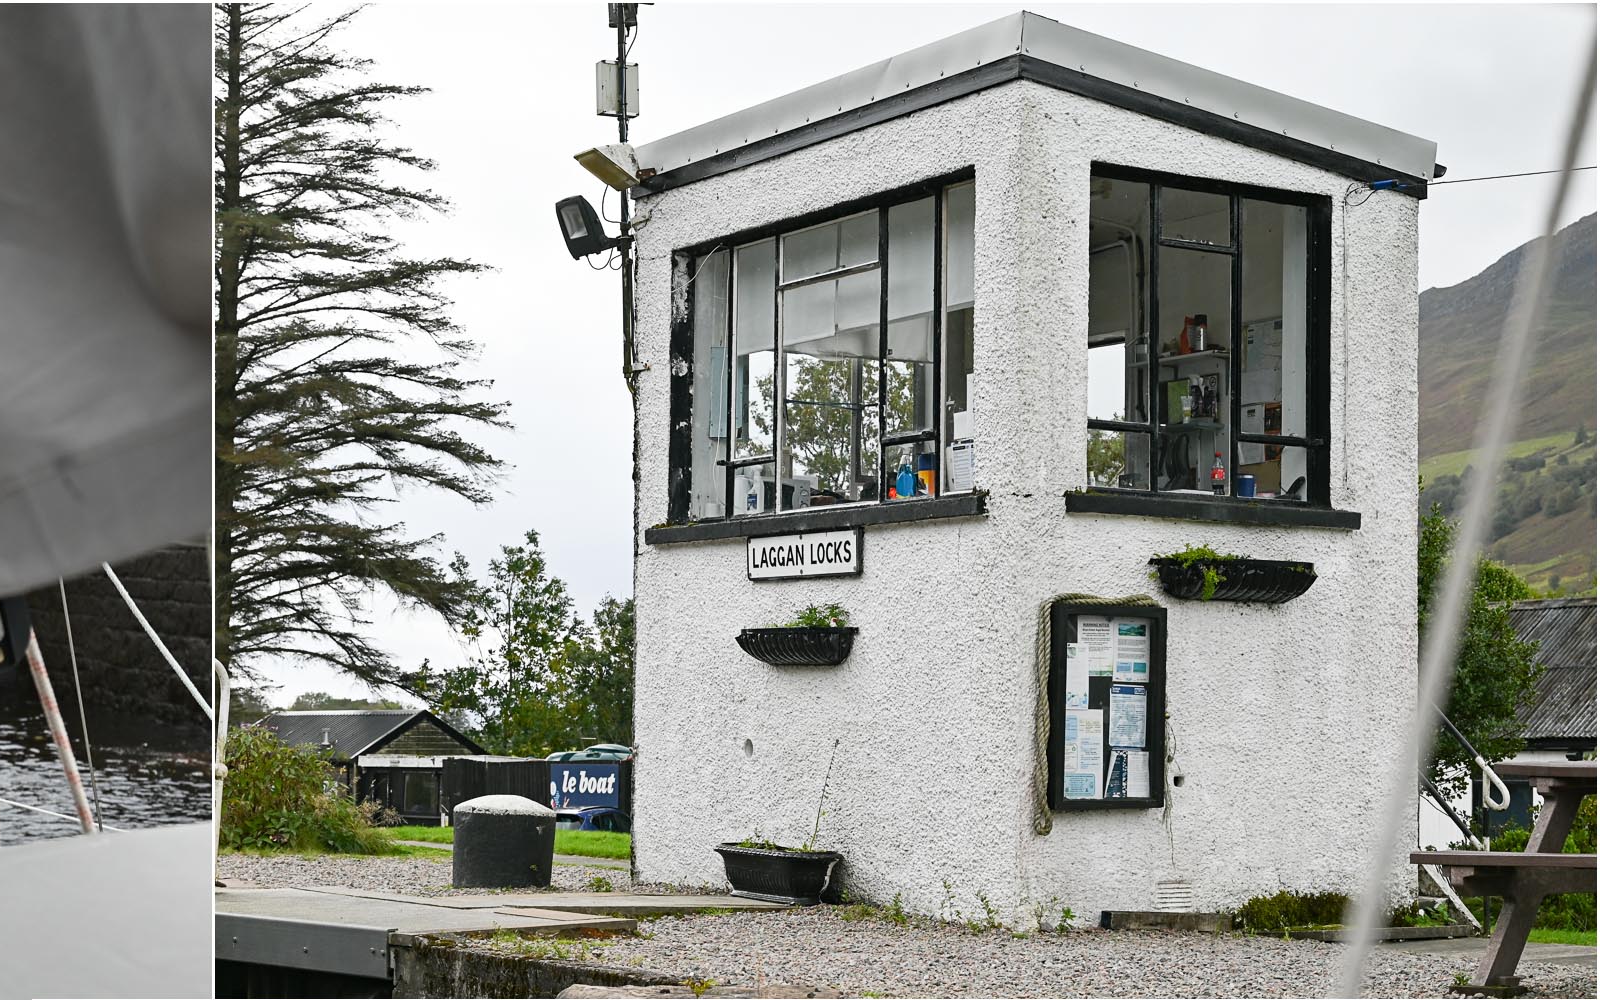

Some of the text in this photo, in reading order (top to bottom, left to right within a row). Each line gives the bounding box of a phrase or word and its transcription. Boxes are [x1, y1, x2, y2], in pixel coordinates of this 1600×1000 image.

[752, 540, 852, 569] LAGGAN LOCKS
[562, 770, 616, 794] le boat
